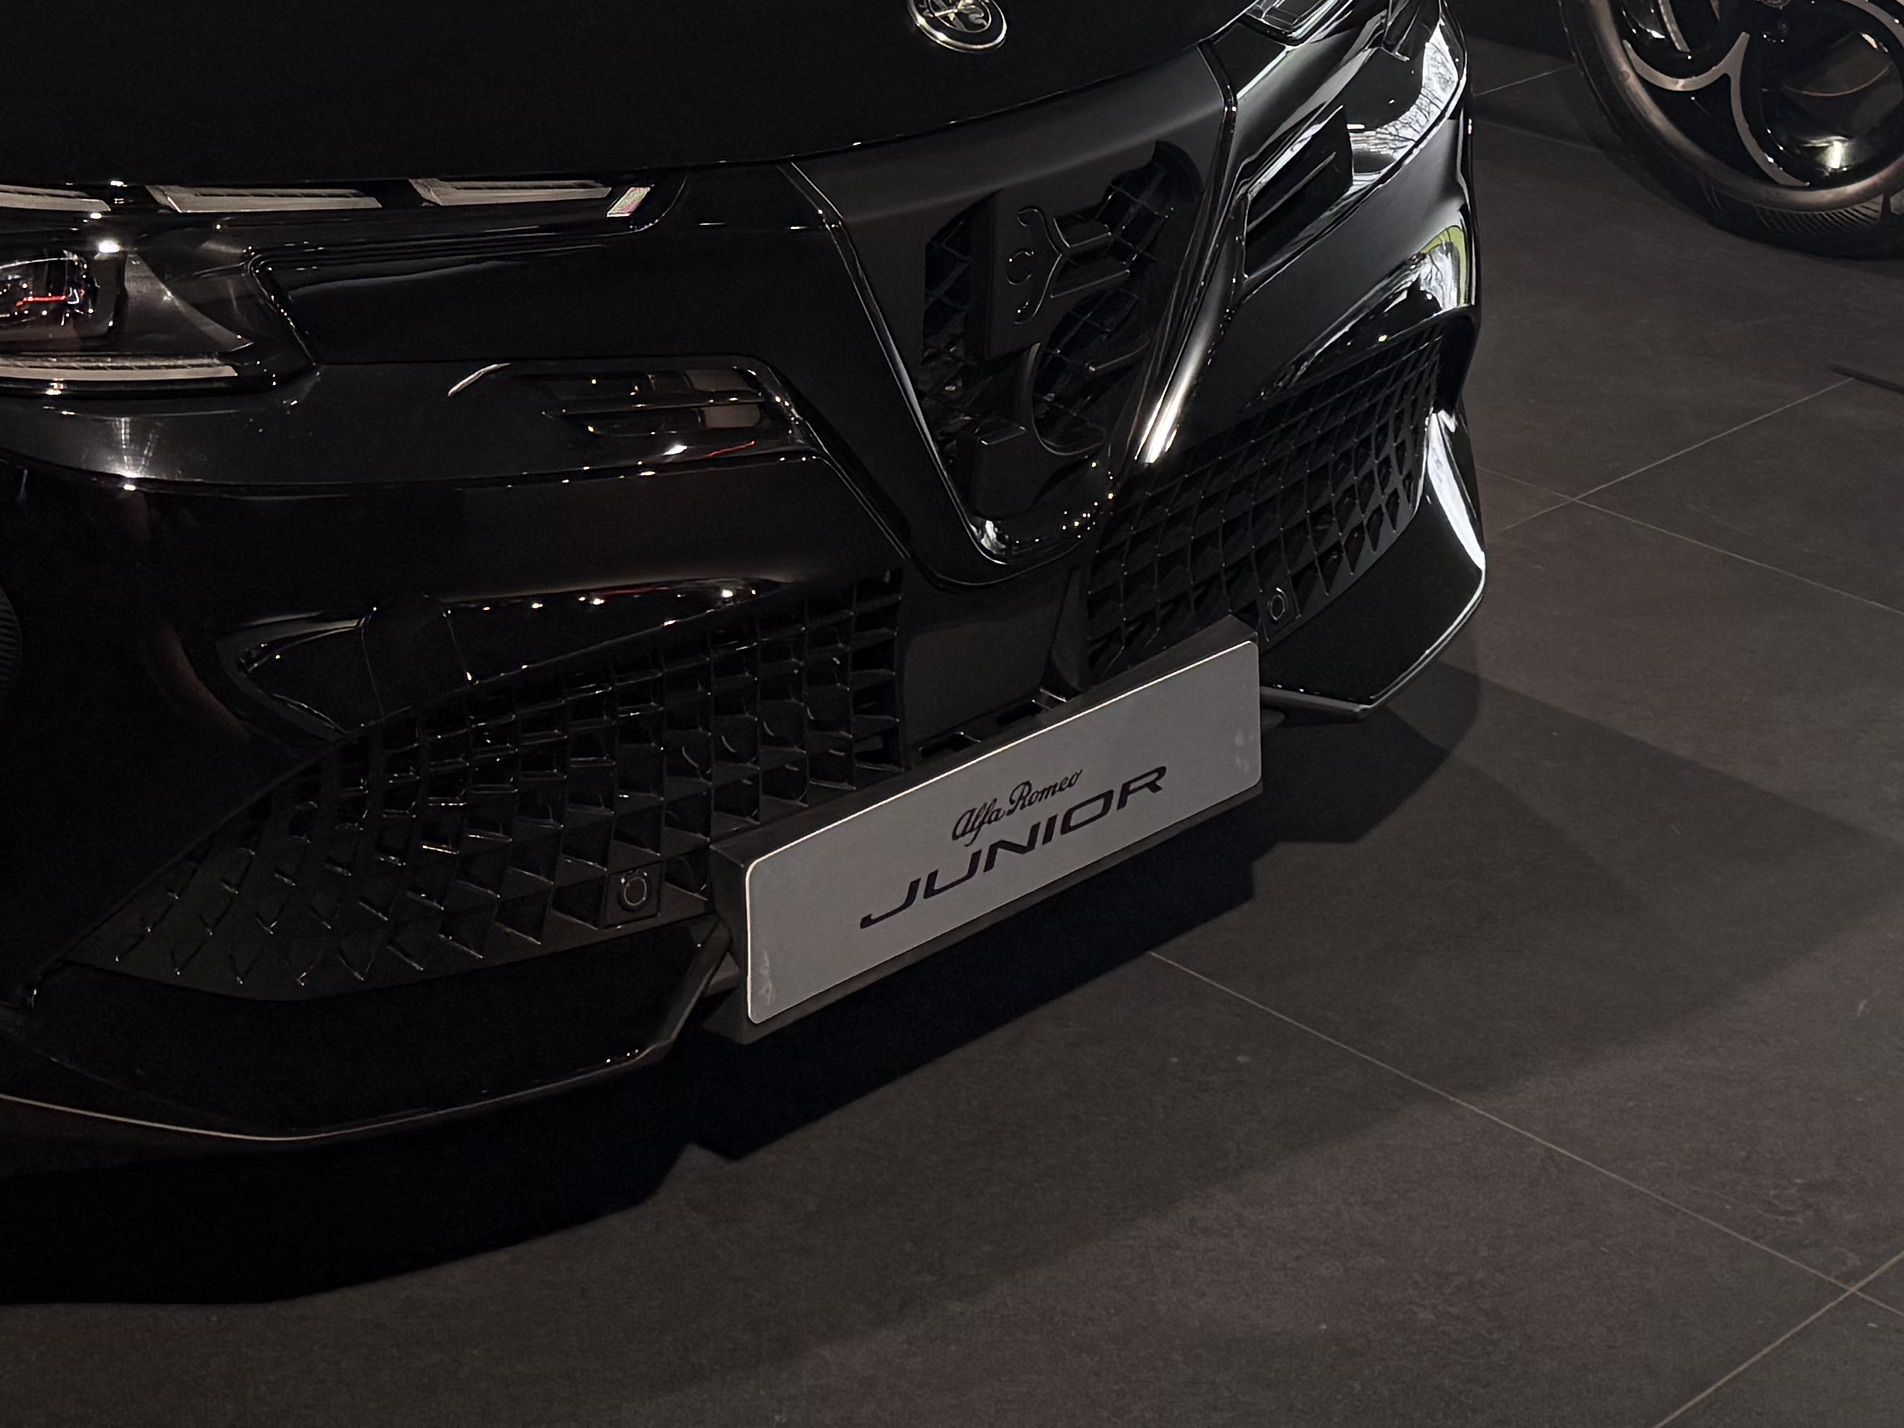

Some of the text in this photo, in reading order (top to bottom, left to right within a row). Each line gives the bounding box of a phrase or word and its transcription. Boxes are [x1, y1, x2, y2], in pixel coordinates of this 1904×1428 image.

[859, 765, 1167, 930] JUNIOR
[951, 768, 1084, 847] Alfa Romeo
